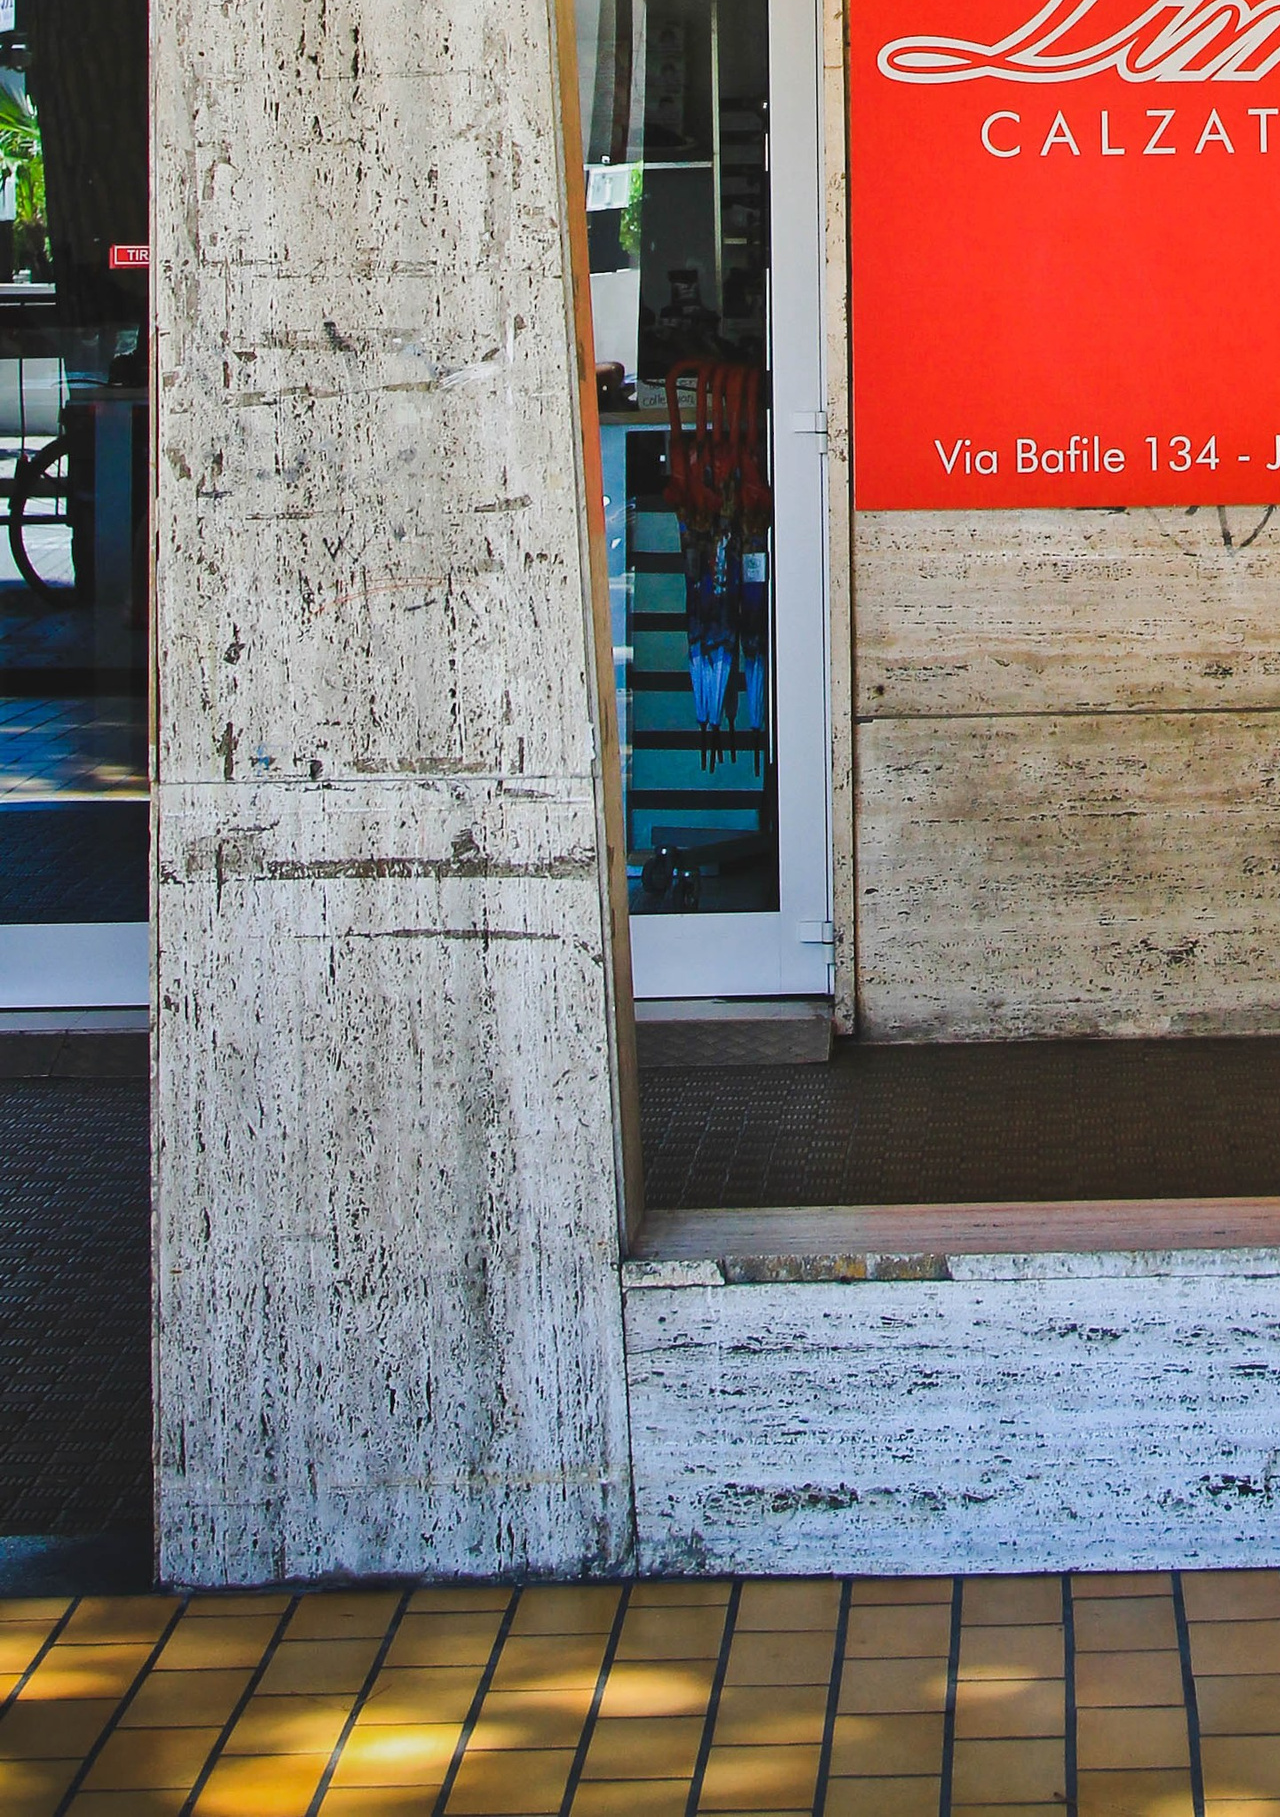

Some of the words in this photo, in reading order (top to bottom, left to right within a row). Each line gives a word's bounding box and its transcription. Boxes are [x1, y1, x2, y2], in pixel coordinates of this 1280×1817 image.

[935, 438, 998, 475] Via
[1016, 435, 1125, 474] Bafile
[1145, 435, 1220, 472] 134
